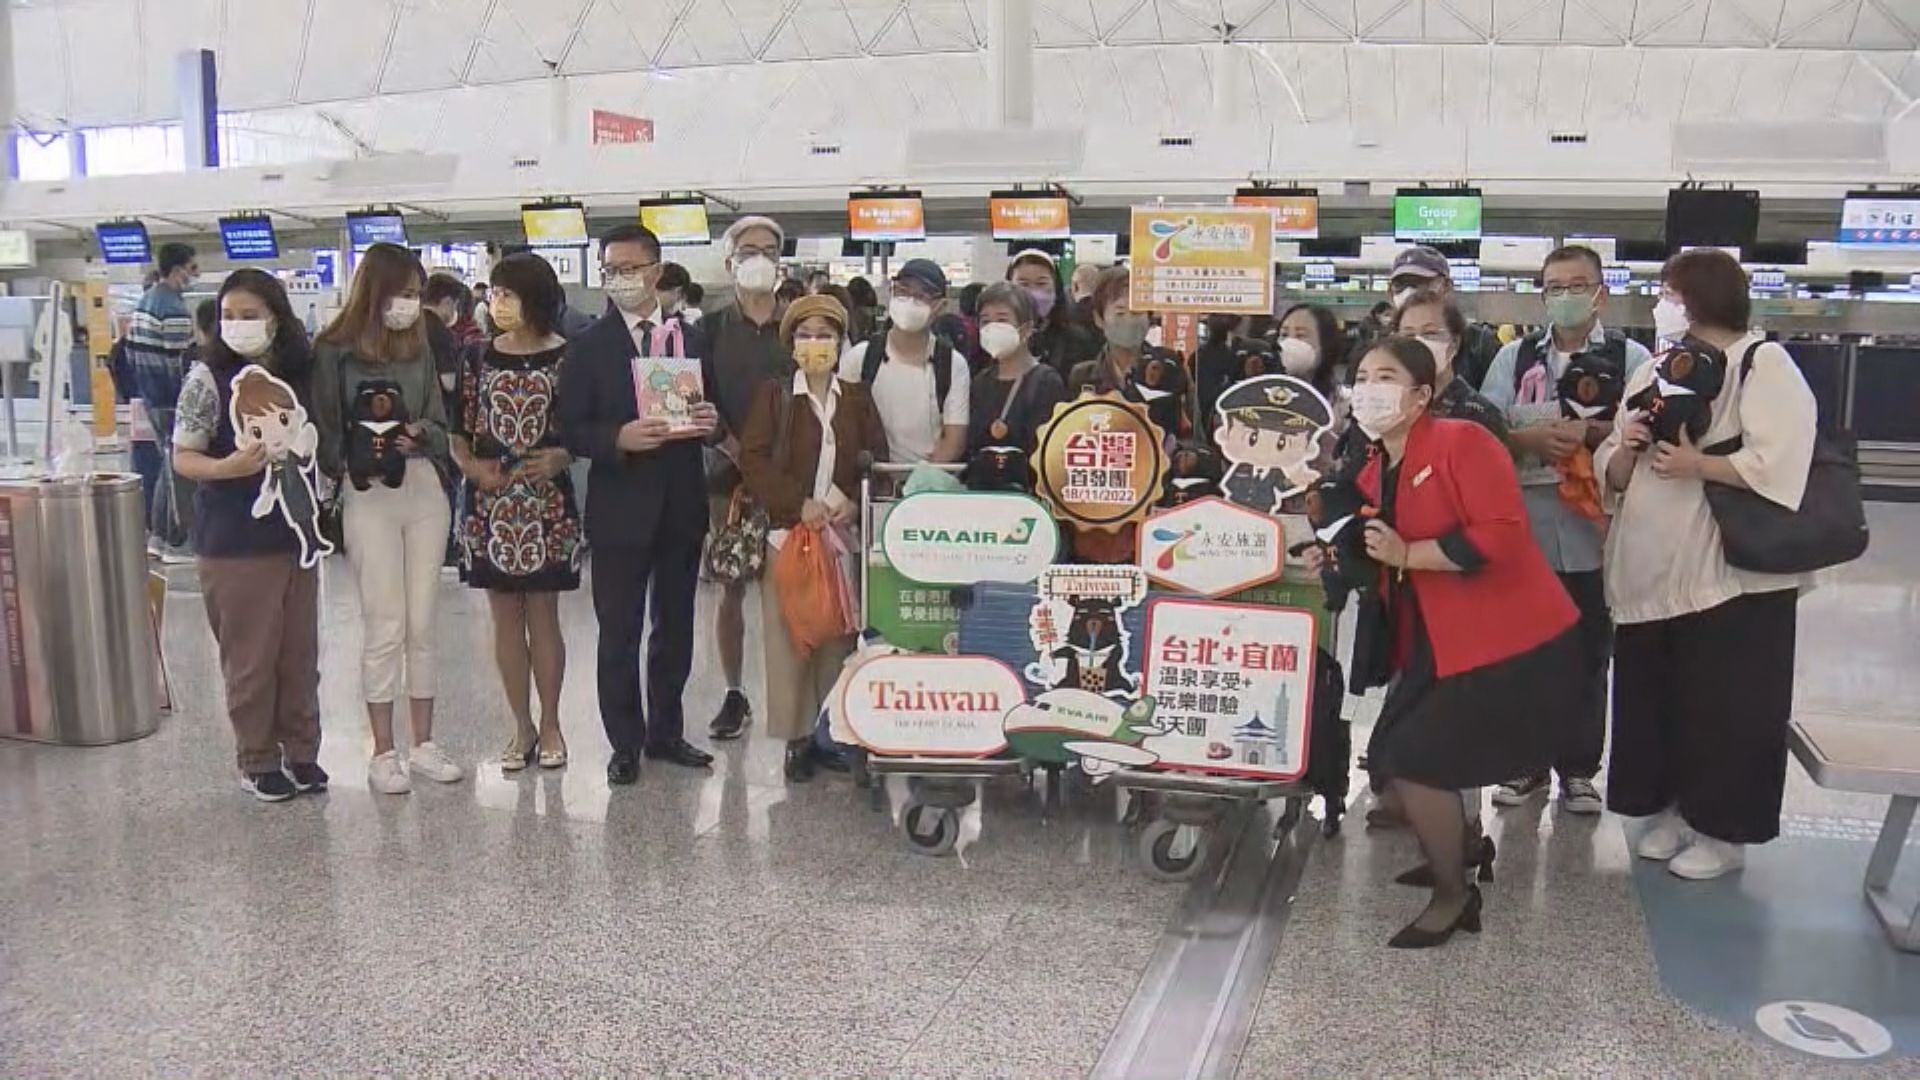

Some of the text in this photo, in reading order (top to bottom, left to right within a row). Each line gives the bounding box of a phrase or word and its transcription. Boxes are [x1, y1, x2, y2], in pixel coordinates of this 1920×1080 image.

[1419, 206, 1458, 221] Group
[1065, 433, 1134, 469] 台灣
[1070, 468, 1127, 488] 首發團
[1064, 488, 1134, 501] 18/11/2022
[902, 530, 998, 543] EVA AIR
[1064, 579, 1121, 592] Taiwan
[1161, 635, 1299, 671] 台北+宜蘭
[869, 681, 999, 712] Taiwan
[1156, 690, 1239, 715] 玩樂體驗
[1155, 716, 1207, 737] 5天團
